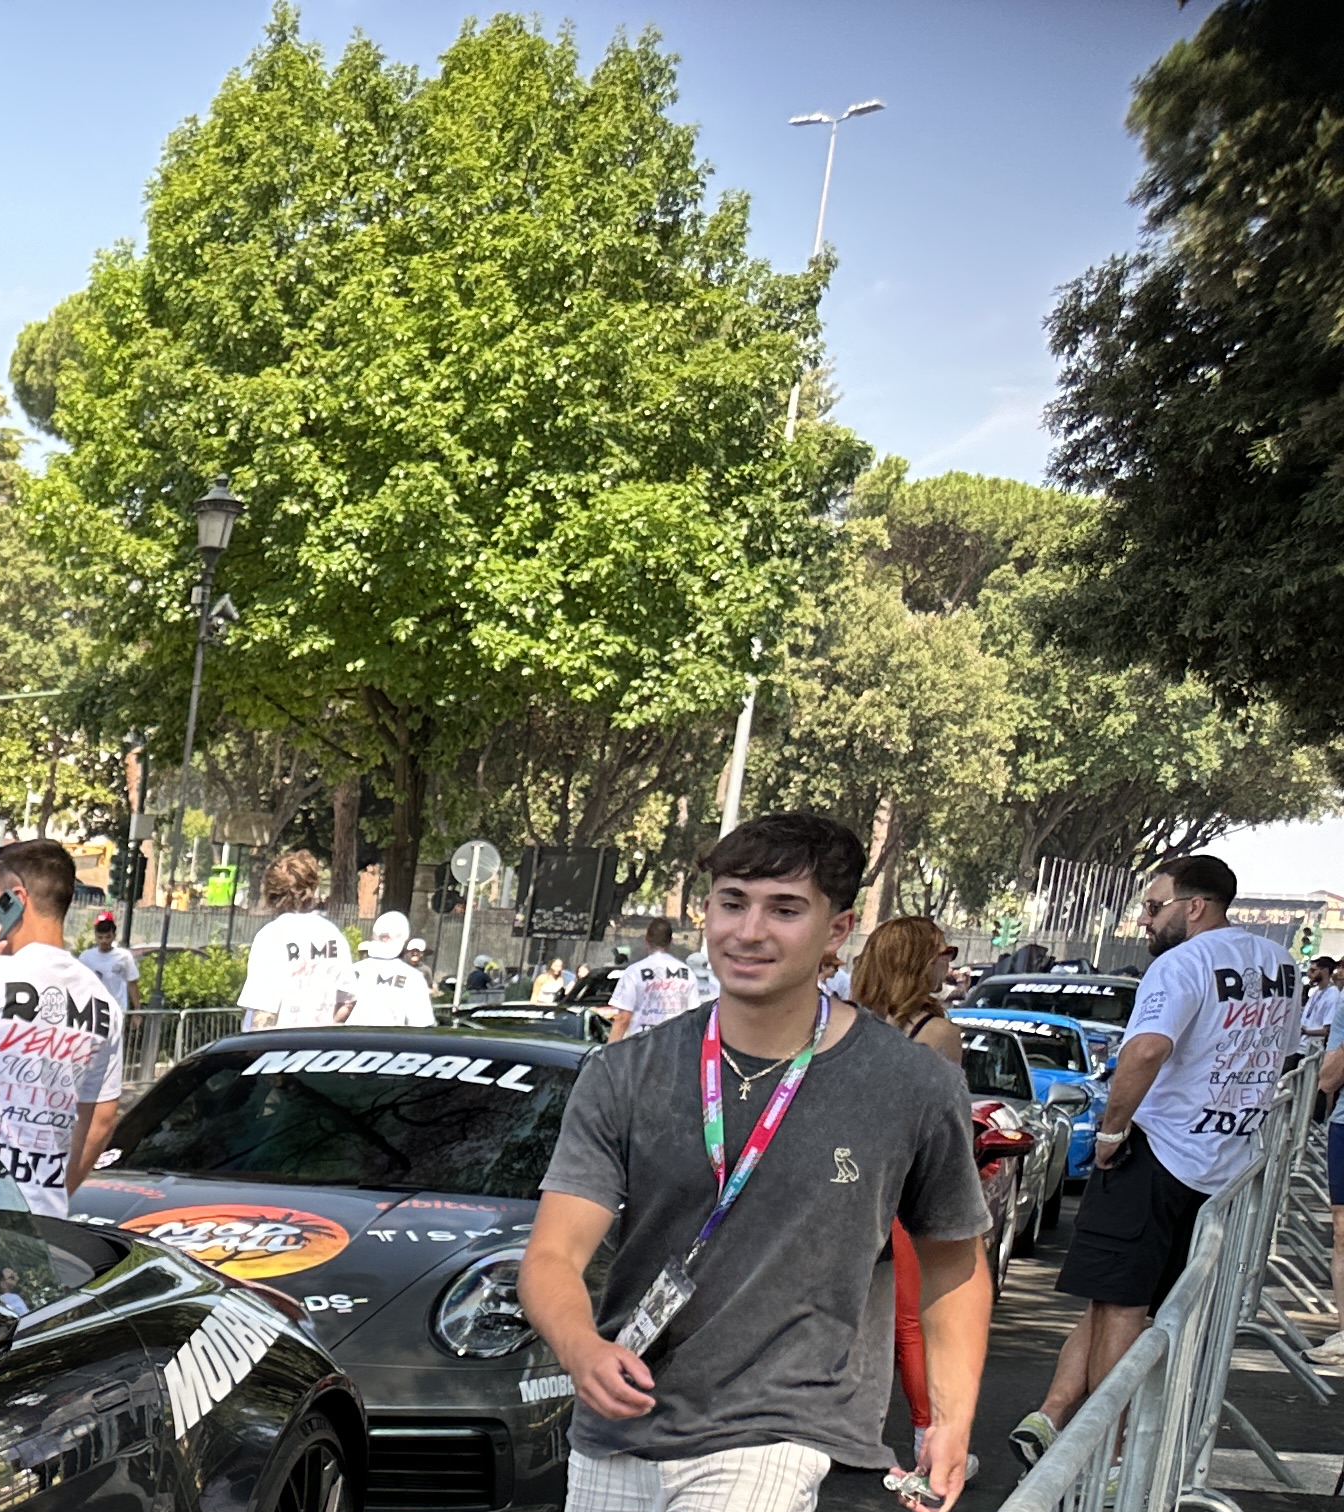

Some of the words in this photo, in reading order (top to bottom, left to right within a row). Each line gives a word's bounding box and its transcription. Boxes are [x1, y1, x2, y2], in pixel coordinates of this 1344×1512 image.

[286, 940, 337, 961] RME
[241, 1050, 534, 1093] MODBALL
[148, 1222, 301, 1239] MOD
